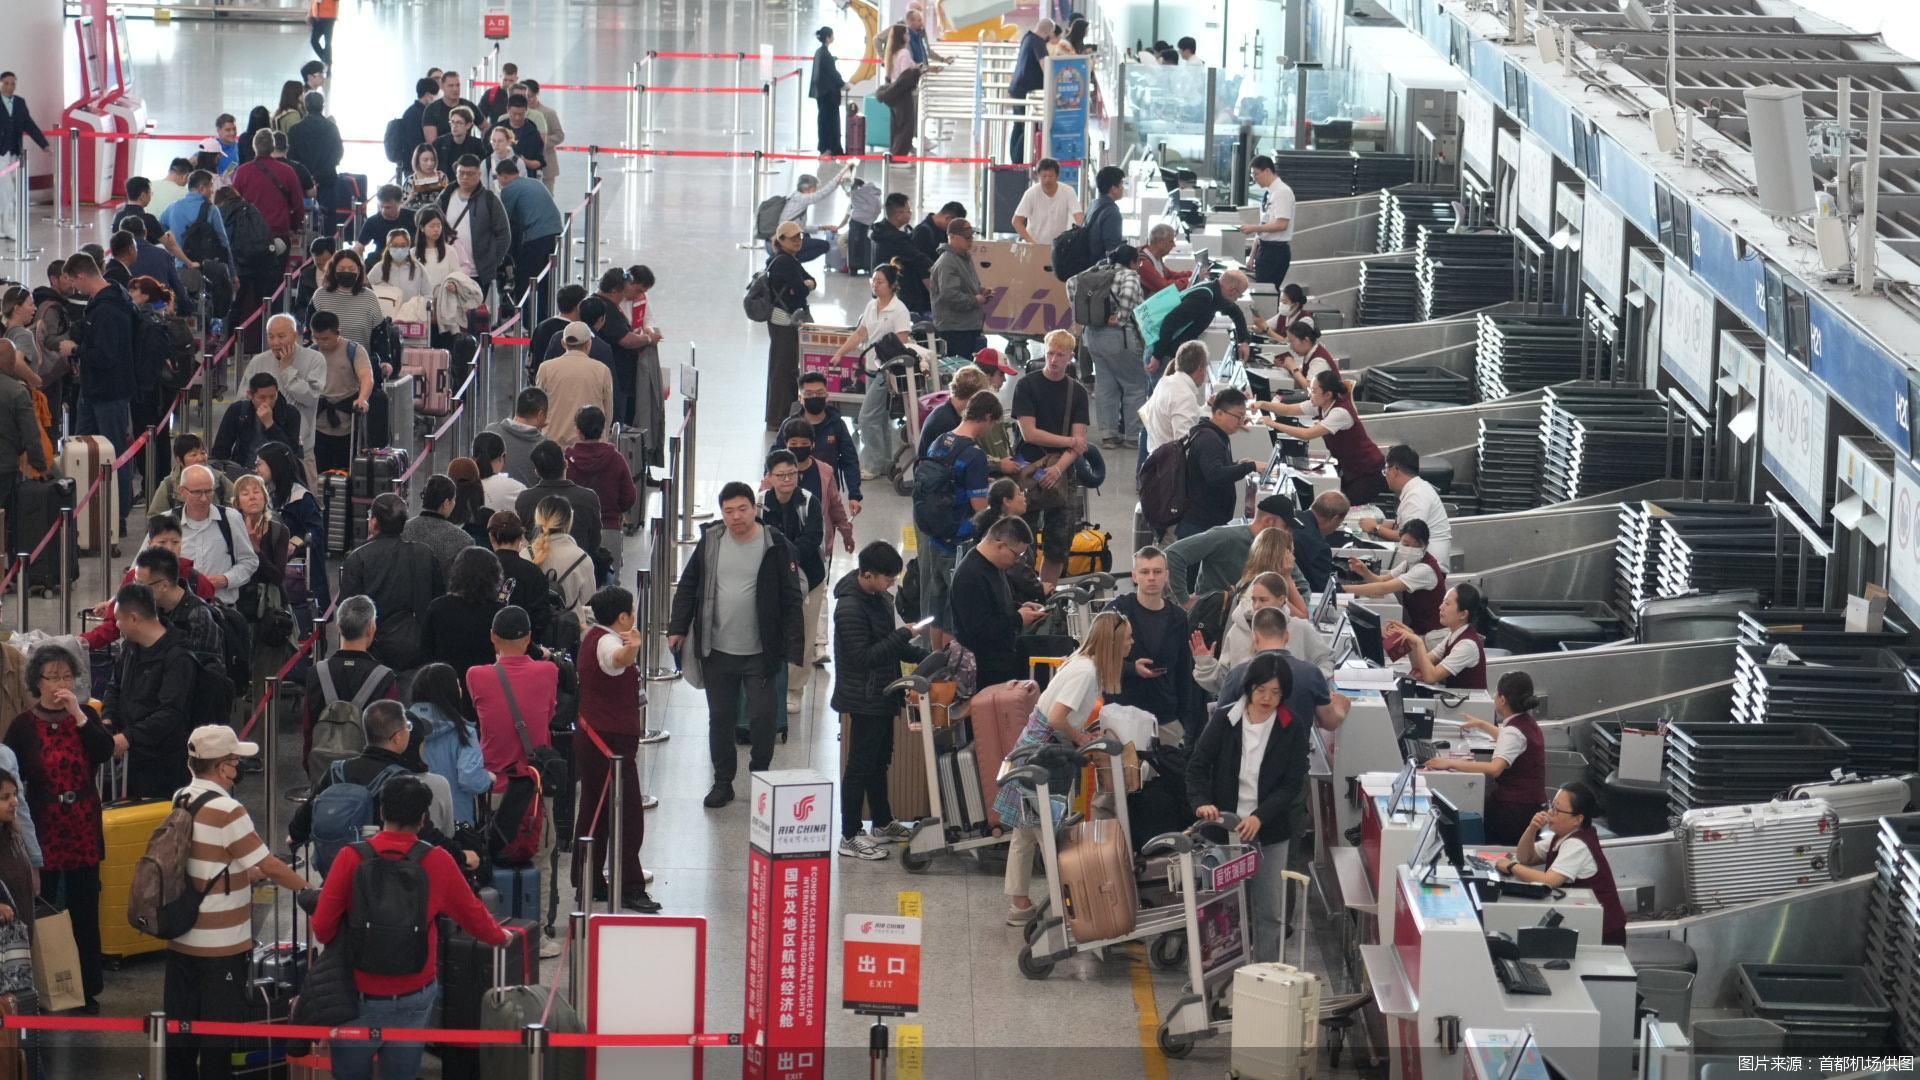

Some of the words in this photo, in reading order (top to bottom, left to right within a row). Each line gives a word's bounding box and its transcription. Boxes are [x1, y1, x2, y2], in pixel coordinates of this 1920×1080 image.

[1810, 322, 1822, 358] H21
[778, 825, 796, 835] AIR
[796, 823, 827, 835] CHINA
[810, 866, 818, 906] ECONOMY
[808, 907, 816, 934] CLASS
[780, 867, 799, 1028] 国际及地区航线经济舱
[807, 935, 815, 973] CHECK-IN
[858, 955, 905, 975] 出口
[806, 974, 814, 1009] SERVICE
[869, 979, 893, 989] EXIT
[777, 1051, 814, 1071] 出口
